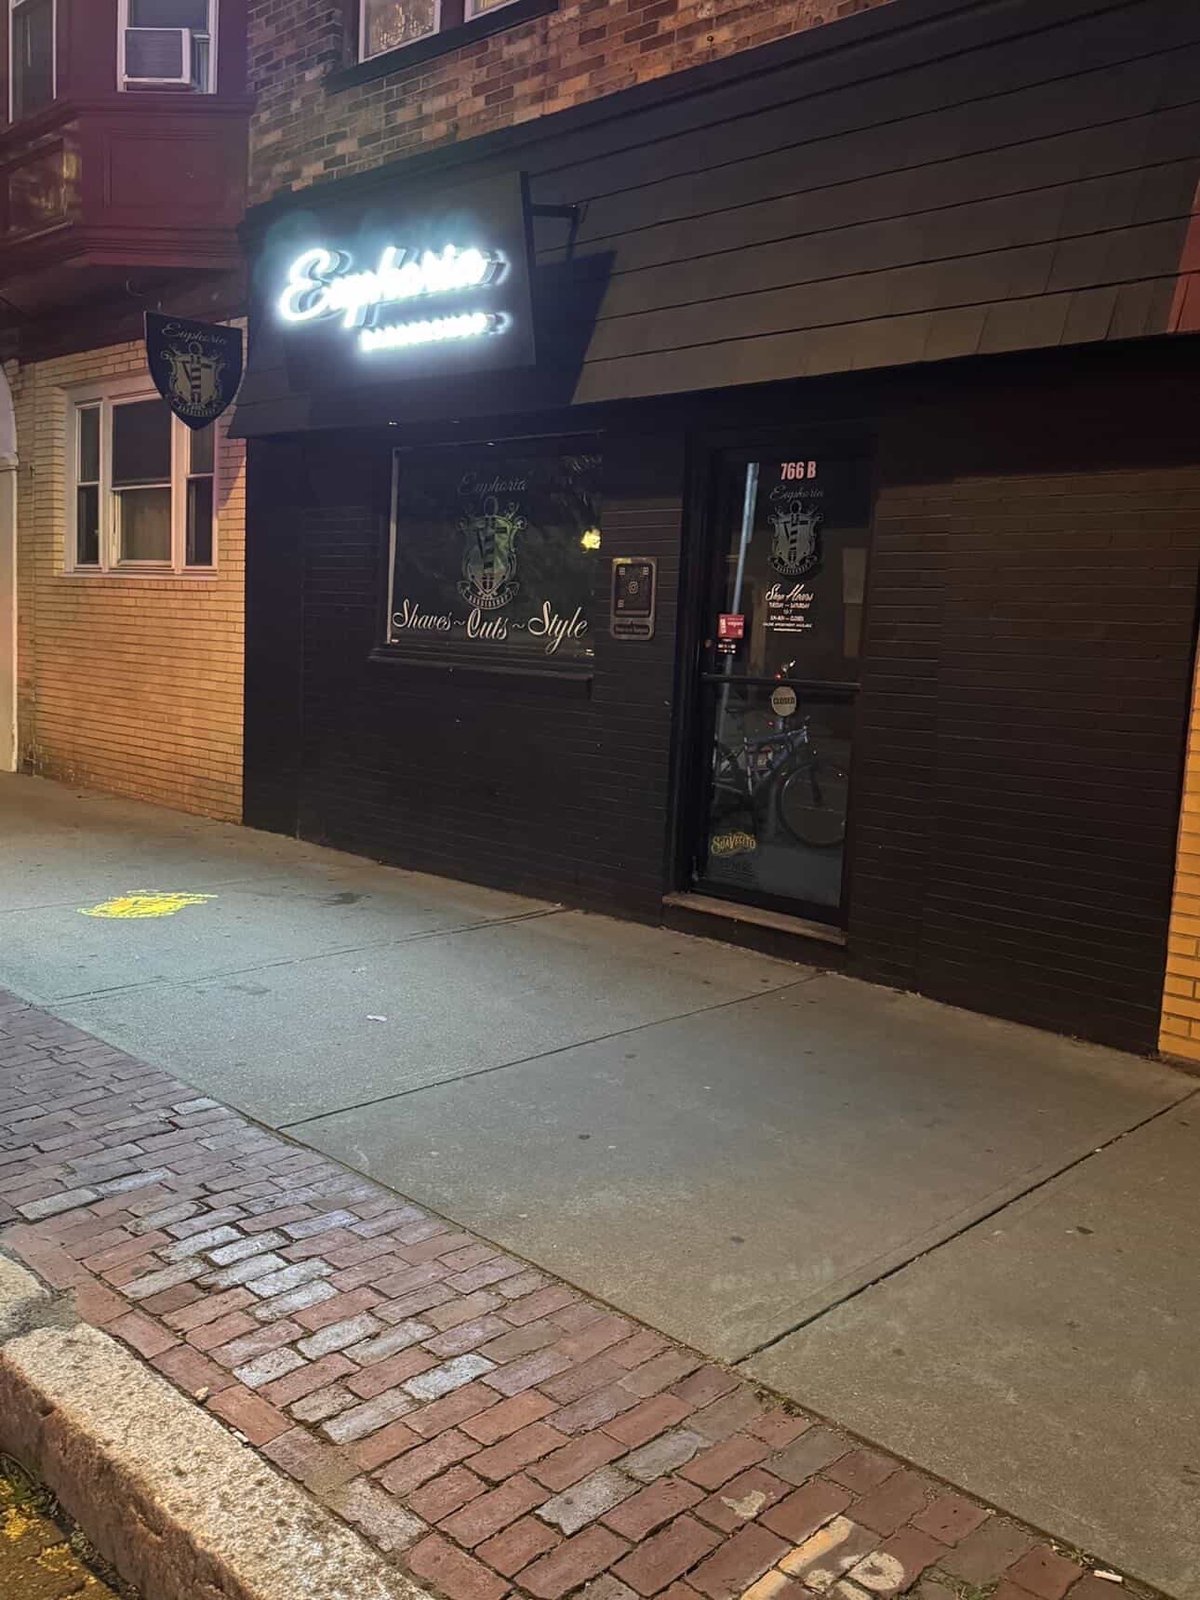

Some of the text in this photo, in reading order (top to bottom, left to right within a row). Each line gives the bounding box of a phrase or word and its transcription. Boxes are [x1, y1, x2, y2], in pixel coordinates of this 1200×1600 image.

[780, 461, 817, 481] 766 B
[456, 472, 529, 498] Euphoria
[392, 598, 589, 655] Shaves Cuts Style
